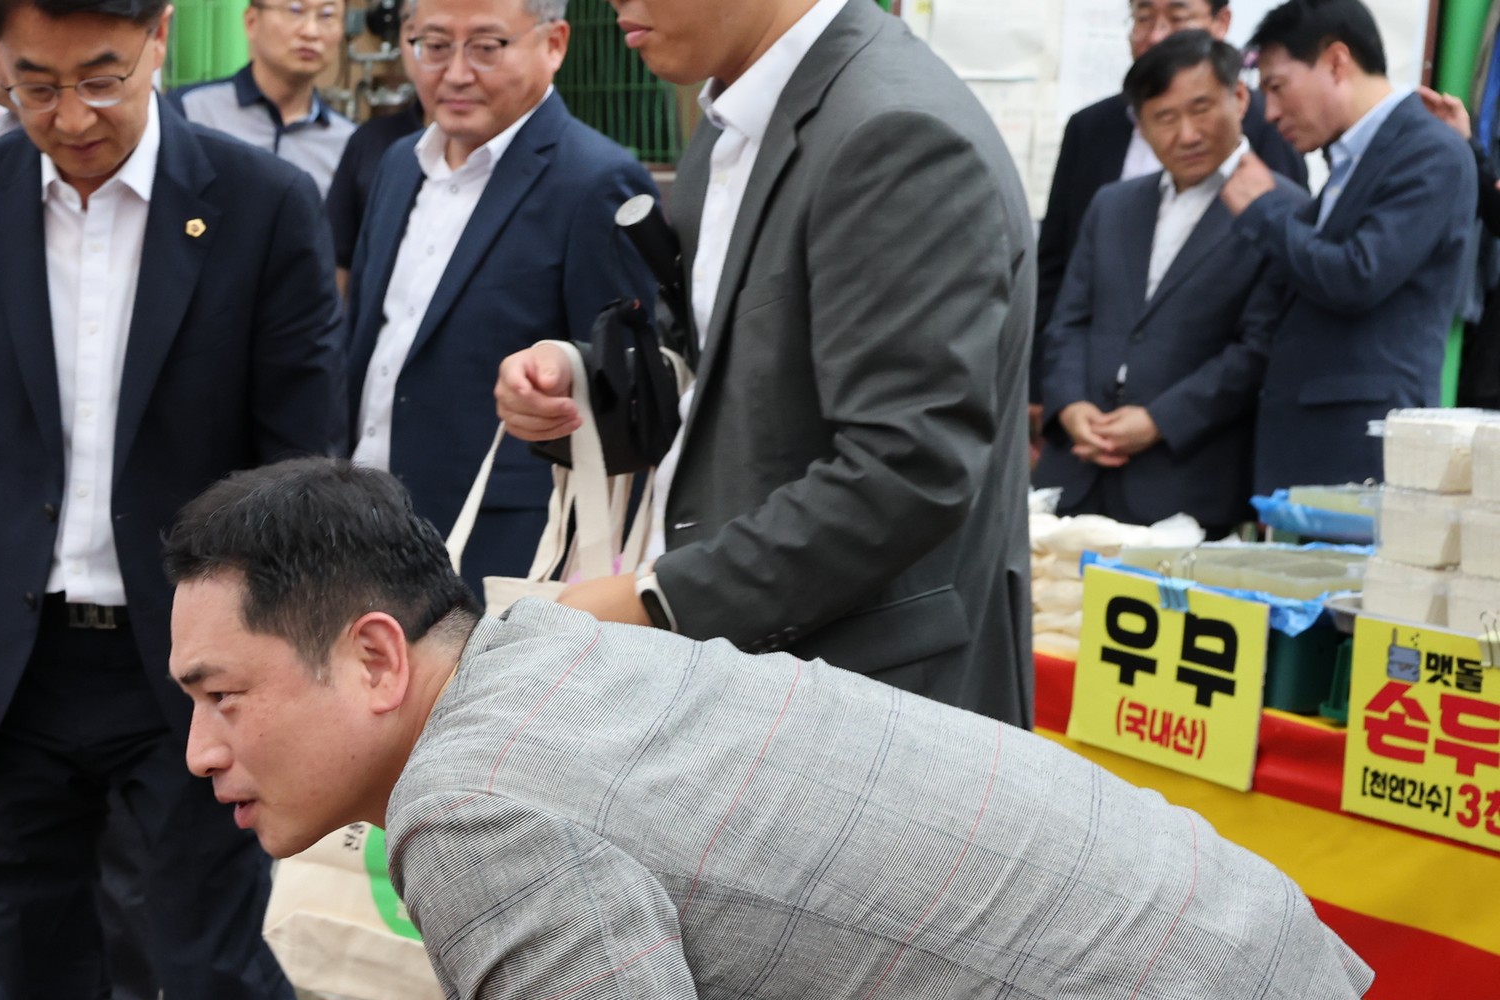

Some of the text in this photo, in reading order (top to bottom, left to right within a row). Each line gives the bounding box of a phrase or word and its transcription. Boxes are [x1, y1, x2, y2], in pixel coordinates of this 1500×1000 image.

[1100, 596, 1238, 709] 우무
[1426, 651, 1483, 694] 맷돌
[1116, 696, 1206, 760] (국내산)
[1362, 766, 1452, 818] [천연간수]
